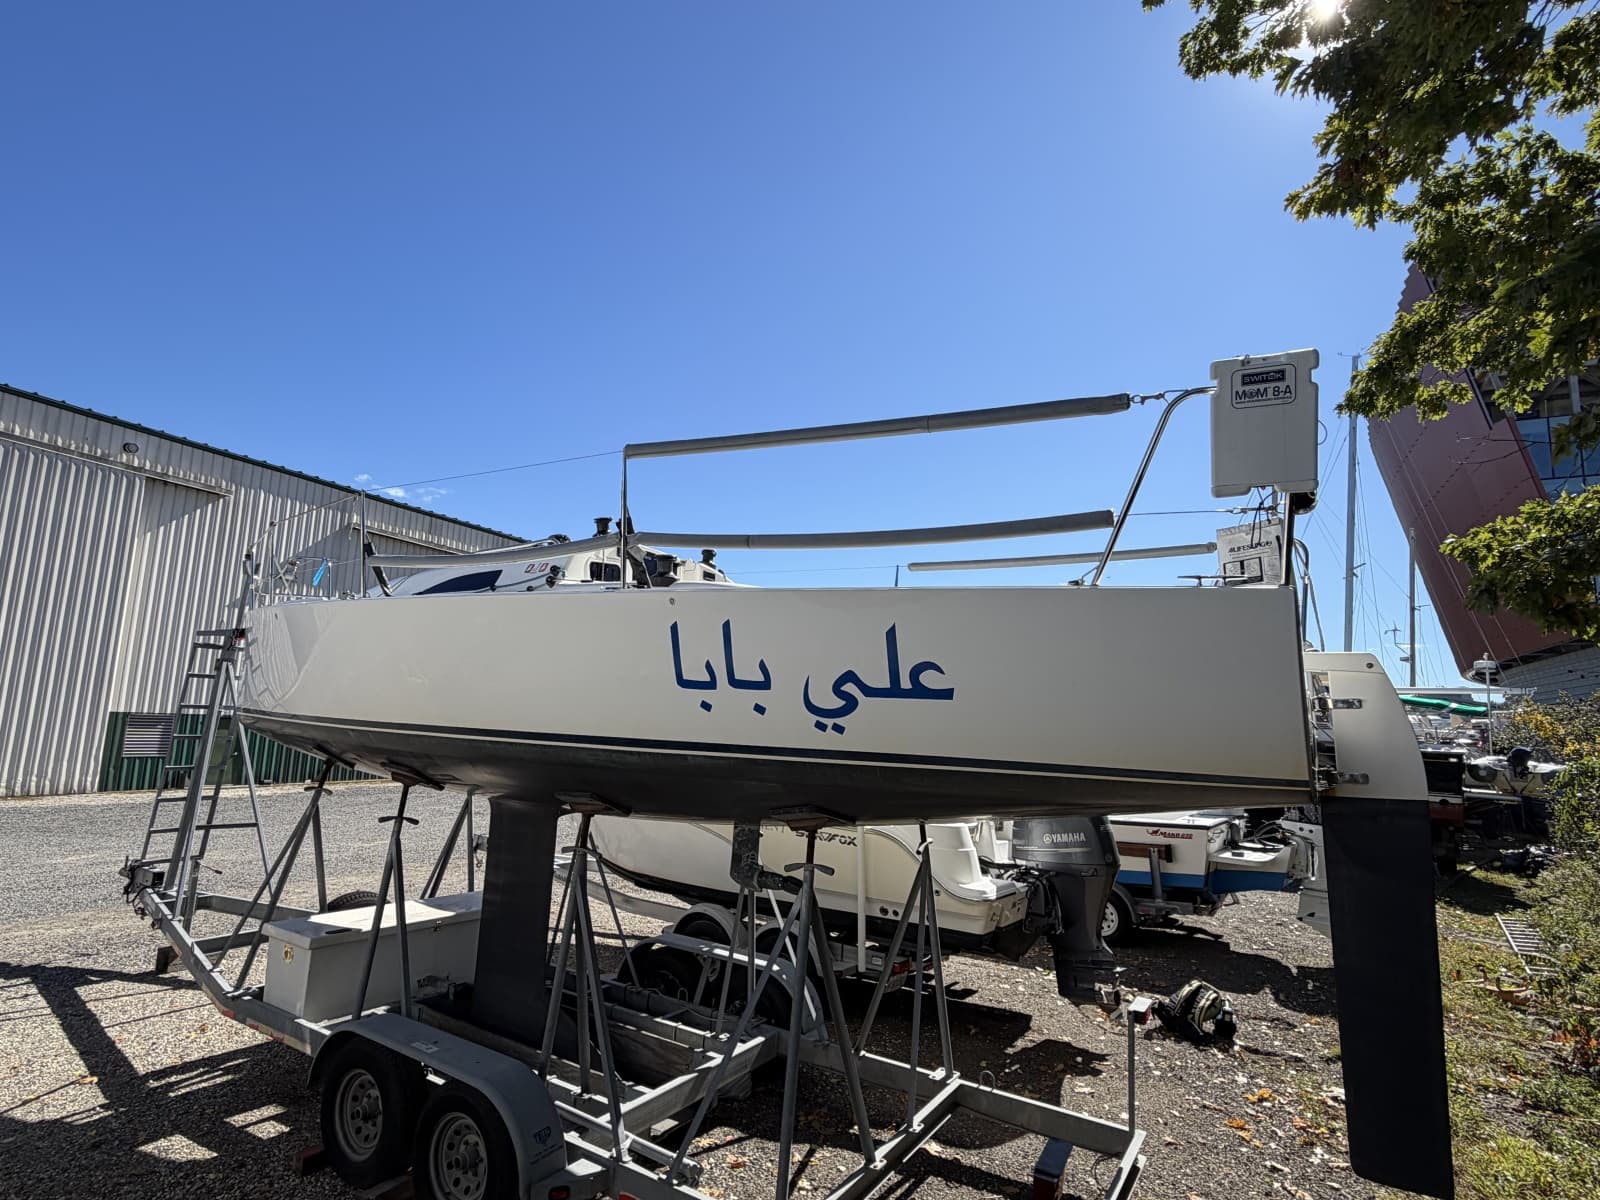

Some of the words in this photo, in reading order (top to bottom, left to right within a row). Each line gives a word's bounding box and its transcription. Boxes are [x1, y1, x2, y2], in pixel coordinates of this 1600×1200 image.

[670, 618, 772, 716] بابا
[802, 622, 955, 735] علي
[1051, 832, 1086, 843] YAMAHA
